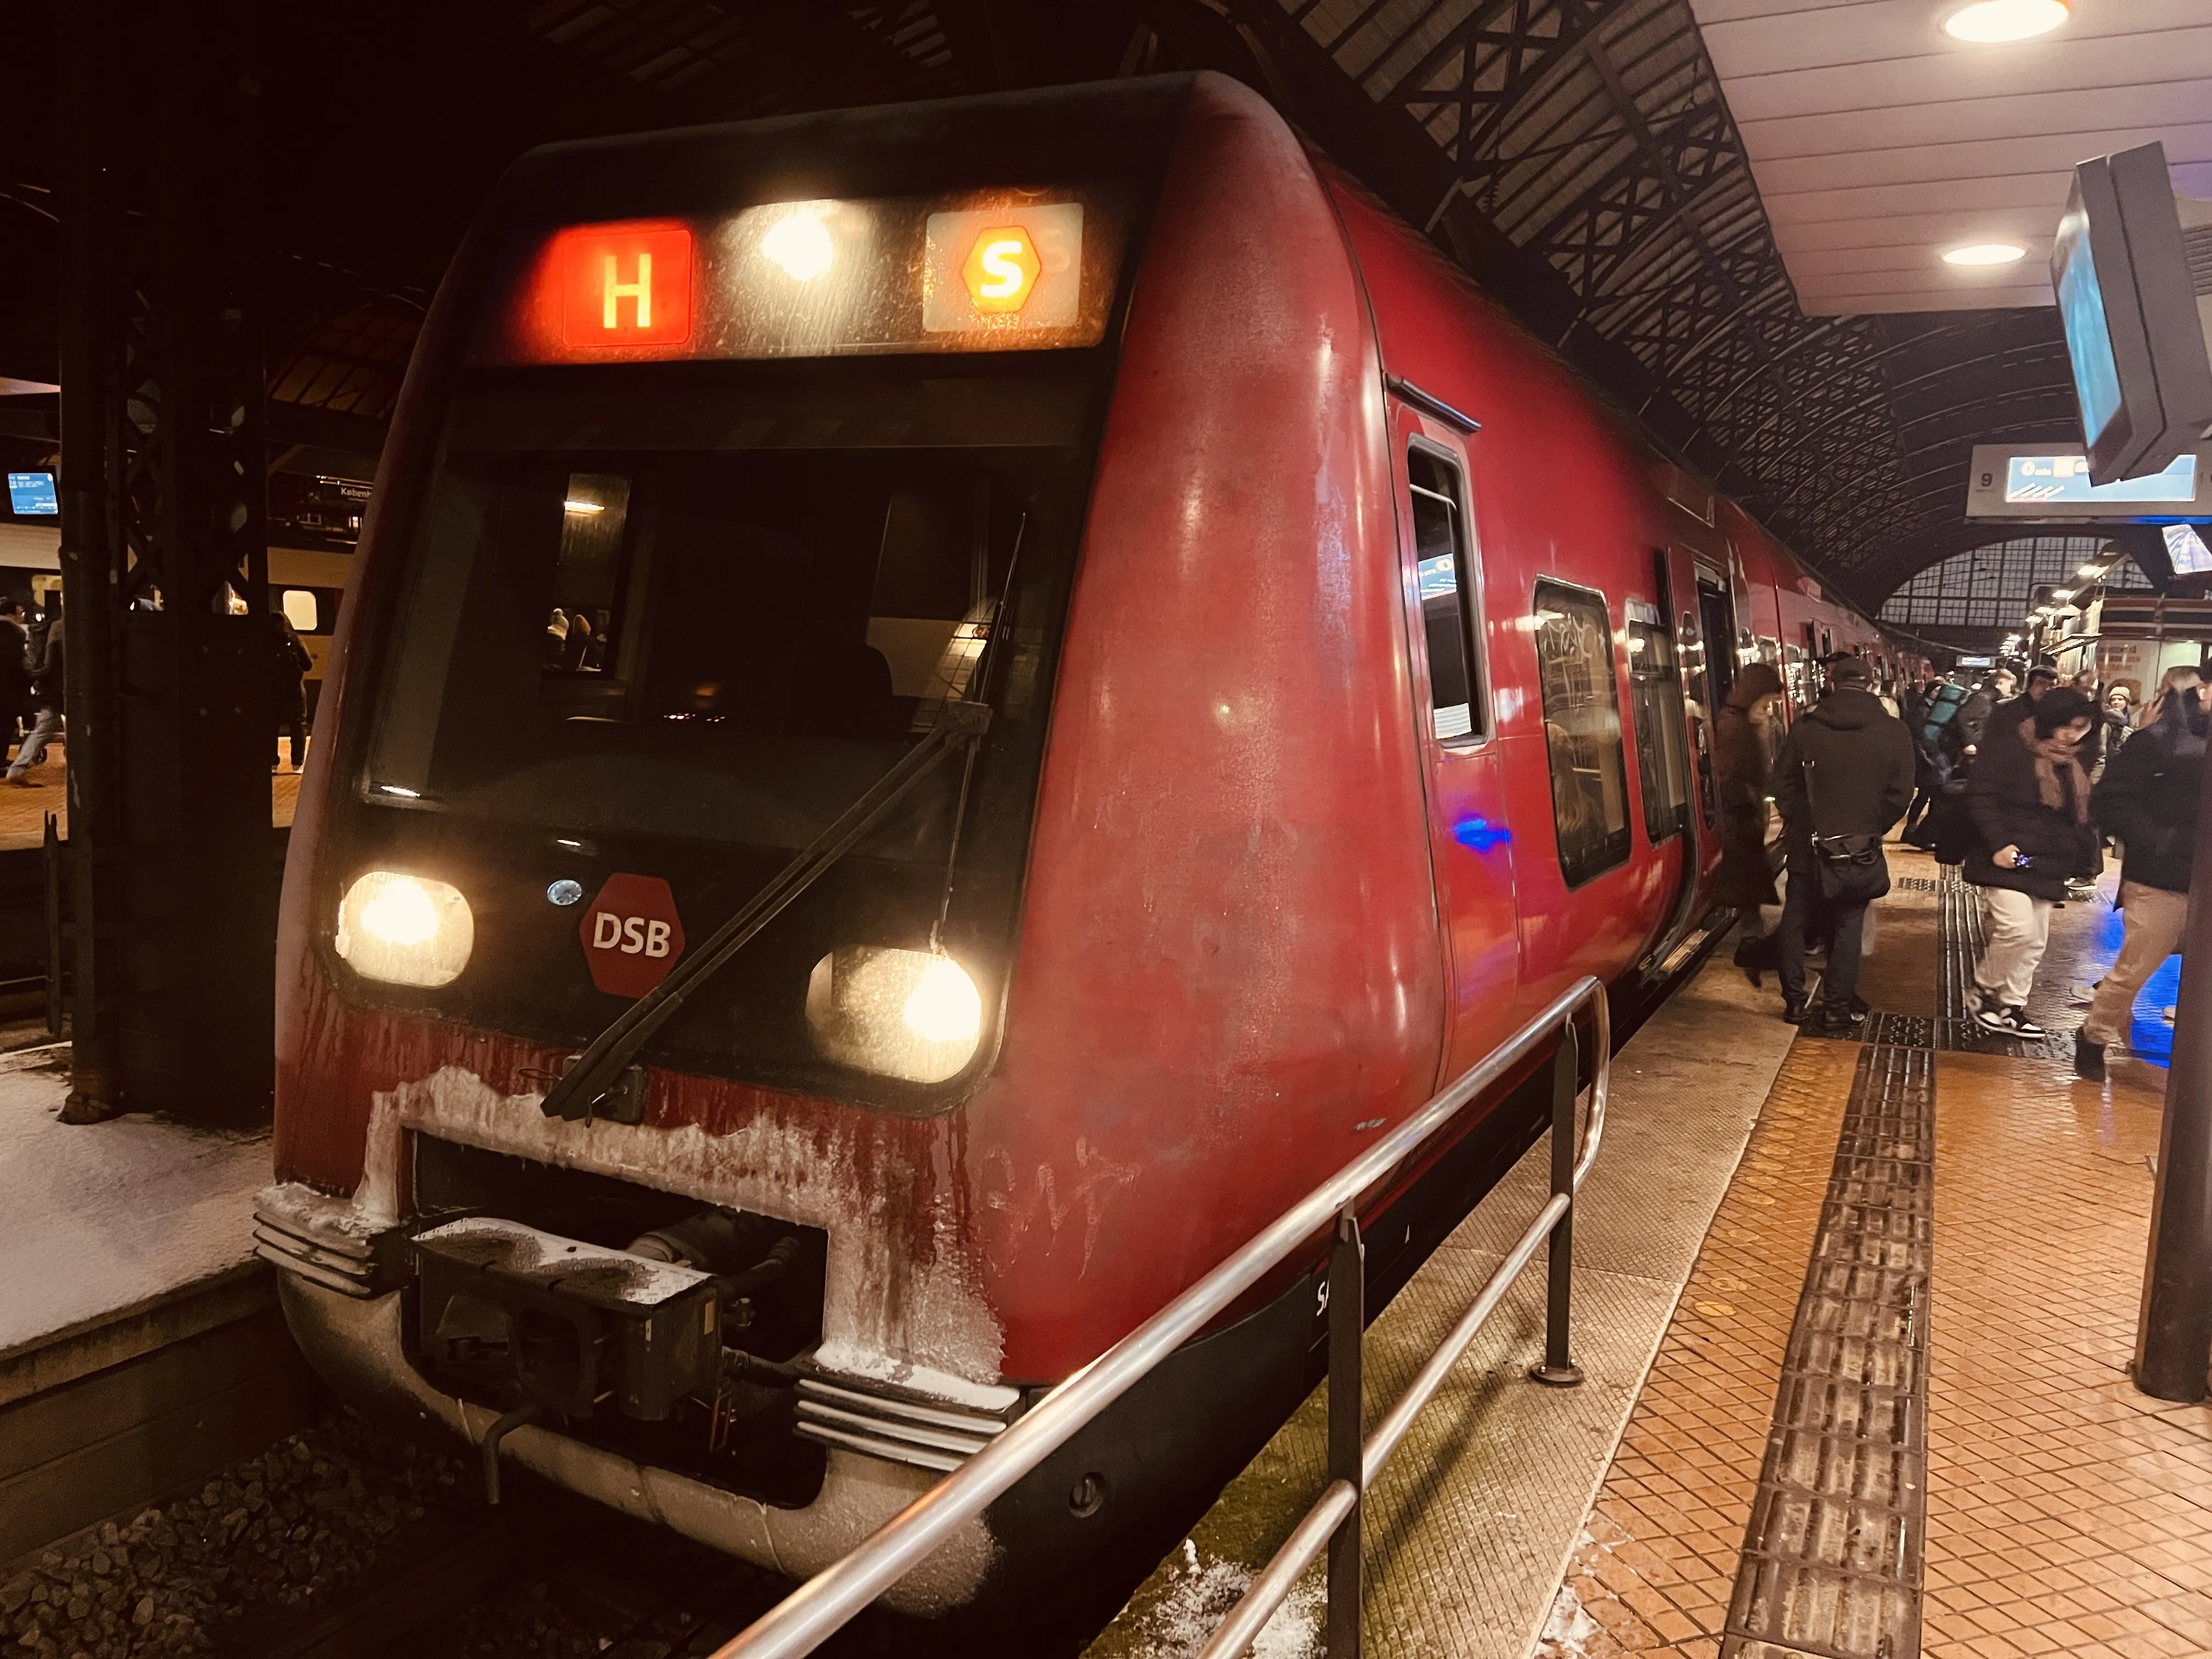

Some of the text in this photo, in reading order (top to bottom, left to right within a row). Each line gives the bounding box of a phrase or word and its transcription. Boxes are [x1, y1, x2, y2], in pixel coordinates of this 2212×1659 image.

[603, 253, 652, 329] H
[980, 240, 1023, 298] S
[1981, 472, 1992, 487] 9
[592, 911, 671, 958] DSB
